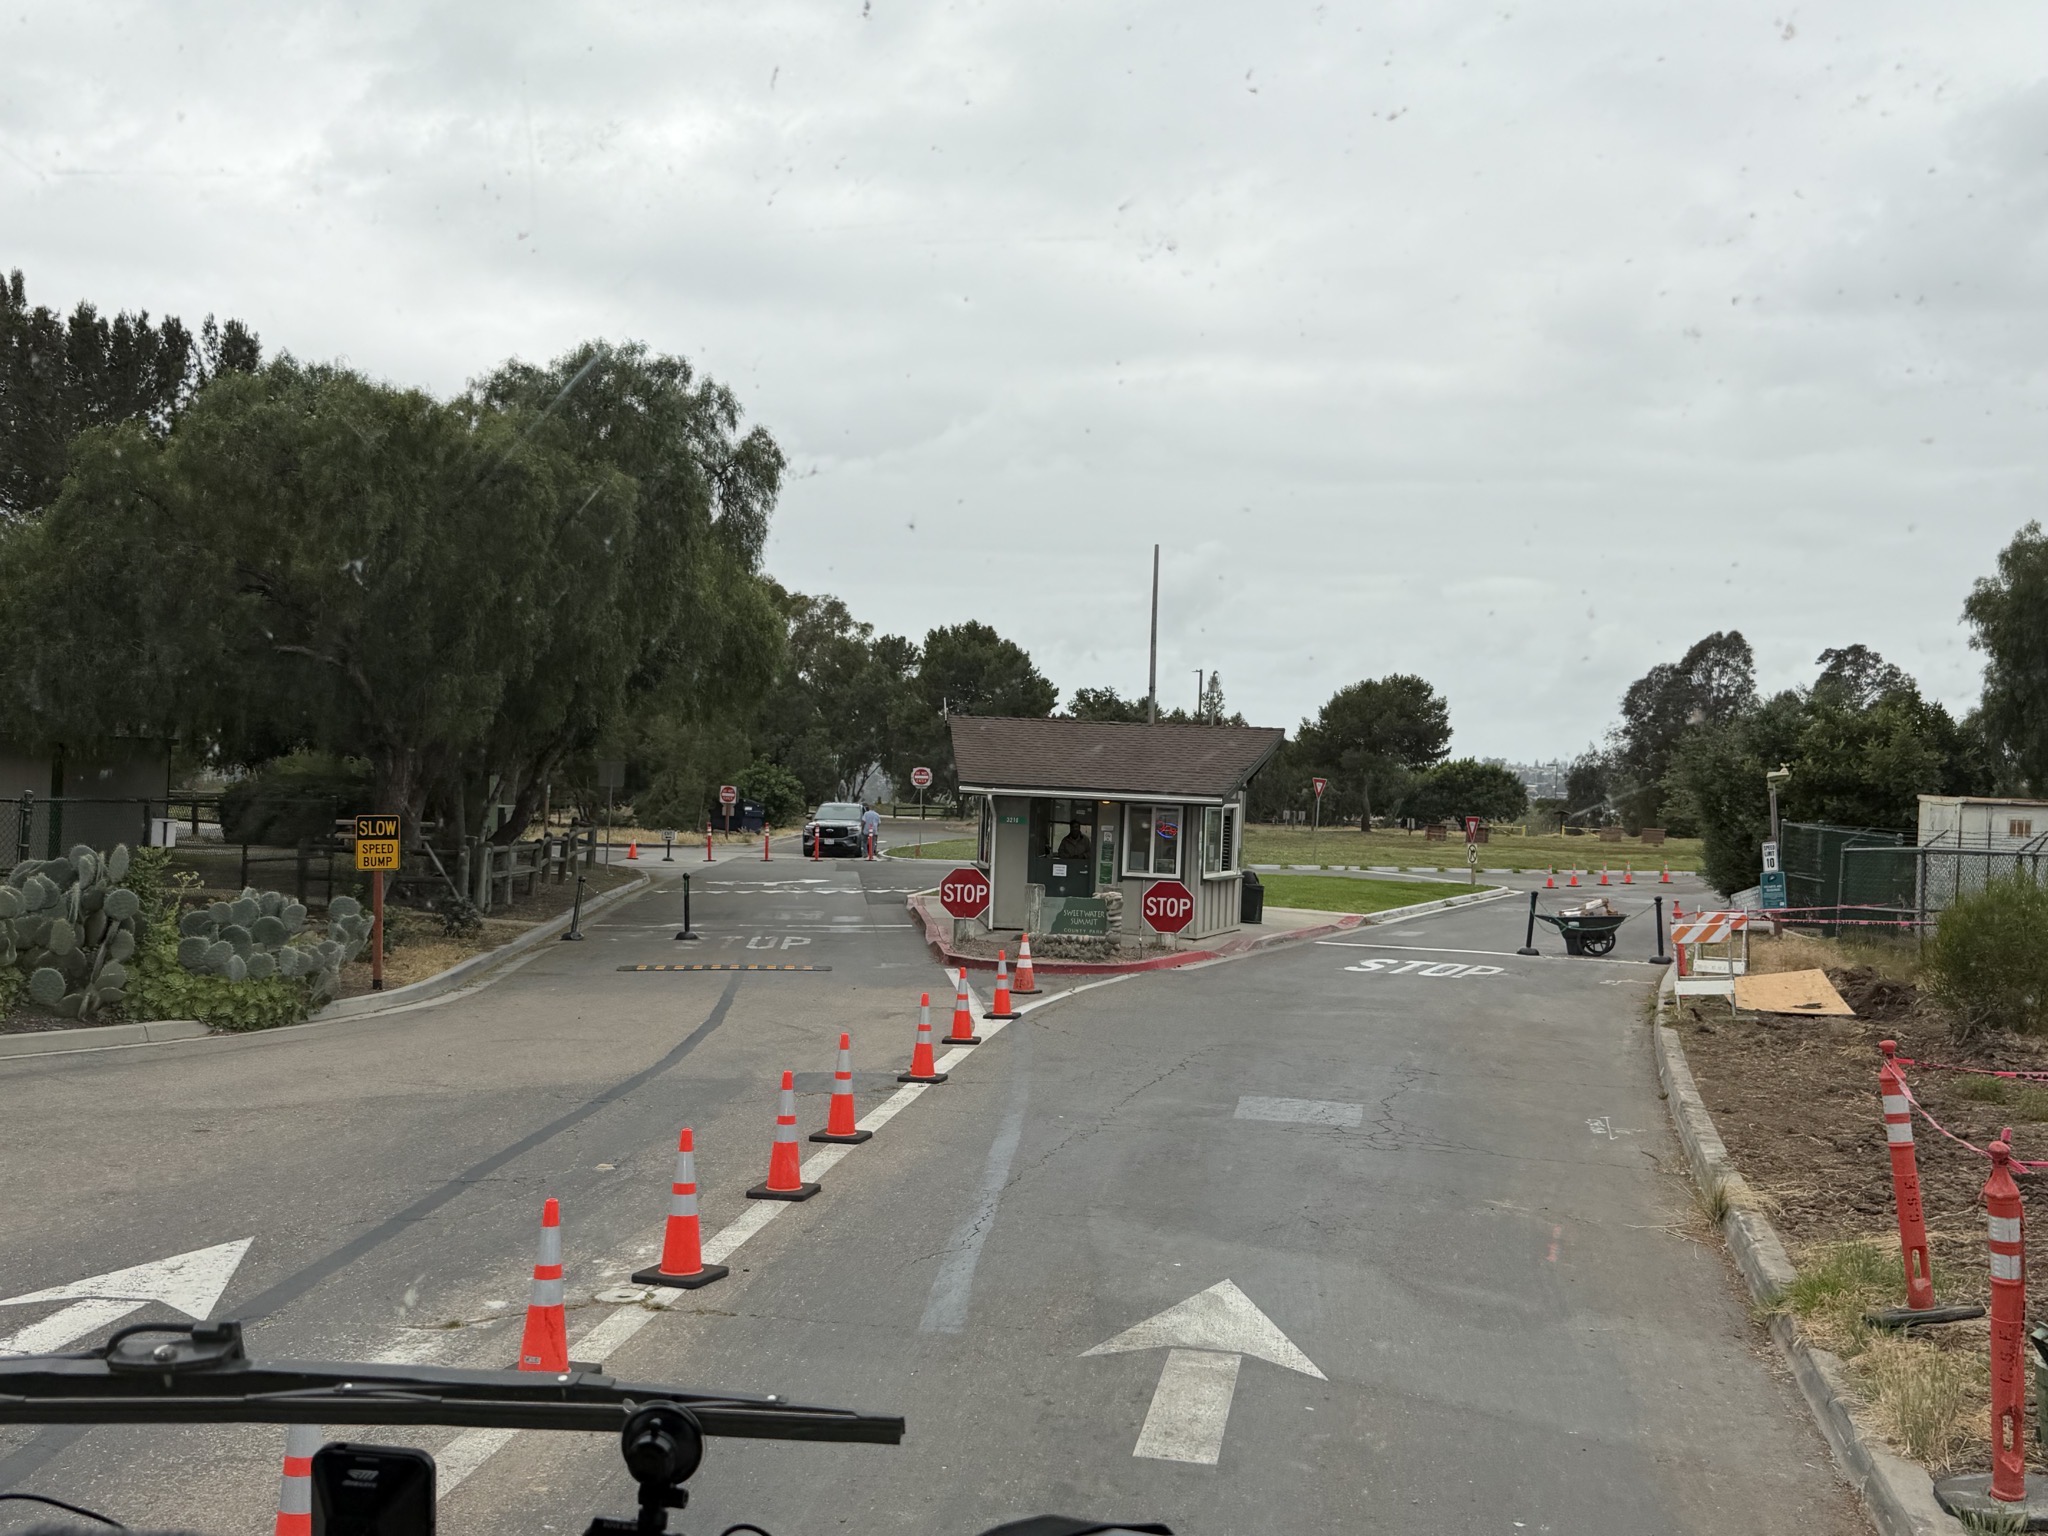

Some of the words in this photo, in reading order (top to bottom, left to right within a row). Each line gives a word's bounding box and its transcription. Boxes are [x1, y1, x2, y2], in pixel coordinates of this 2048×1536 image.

[359, 820, 397, 836] SLOW
[362, 843, 394, 854] SPEED
[363, 856, 393, 866] BUMP
[1766, 857, 1775, 868] 10
[943, 883, 988, 903] STOP
[1146, 896, 1191, 917] STOP
[1063, 909, 1105, 918] SWEETWATER
[1344, 958, 1505, 978] STOP
